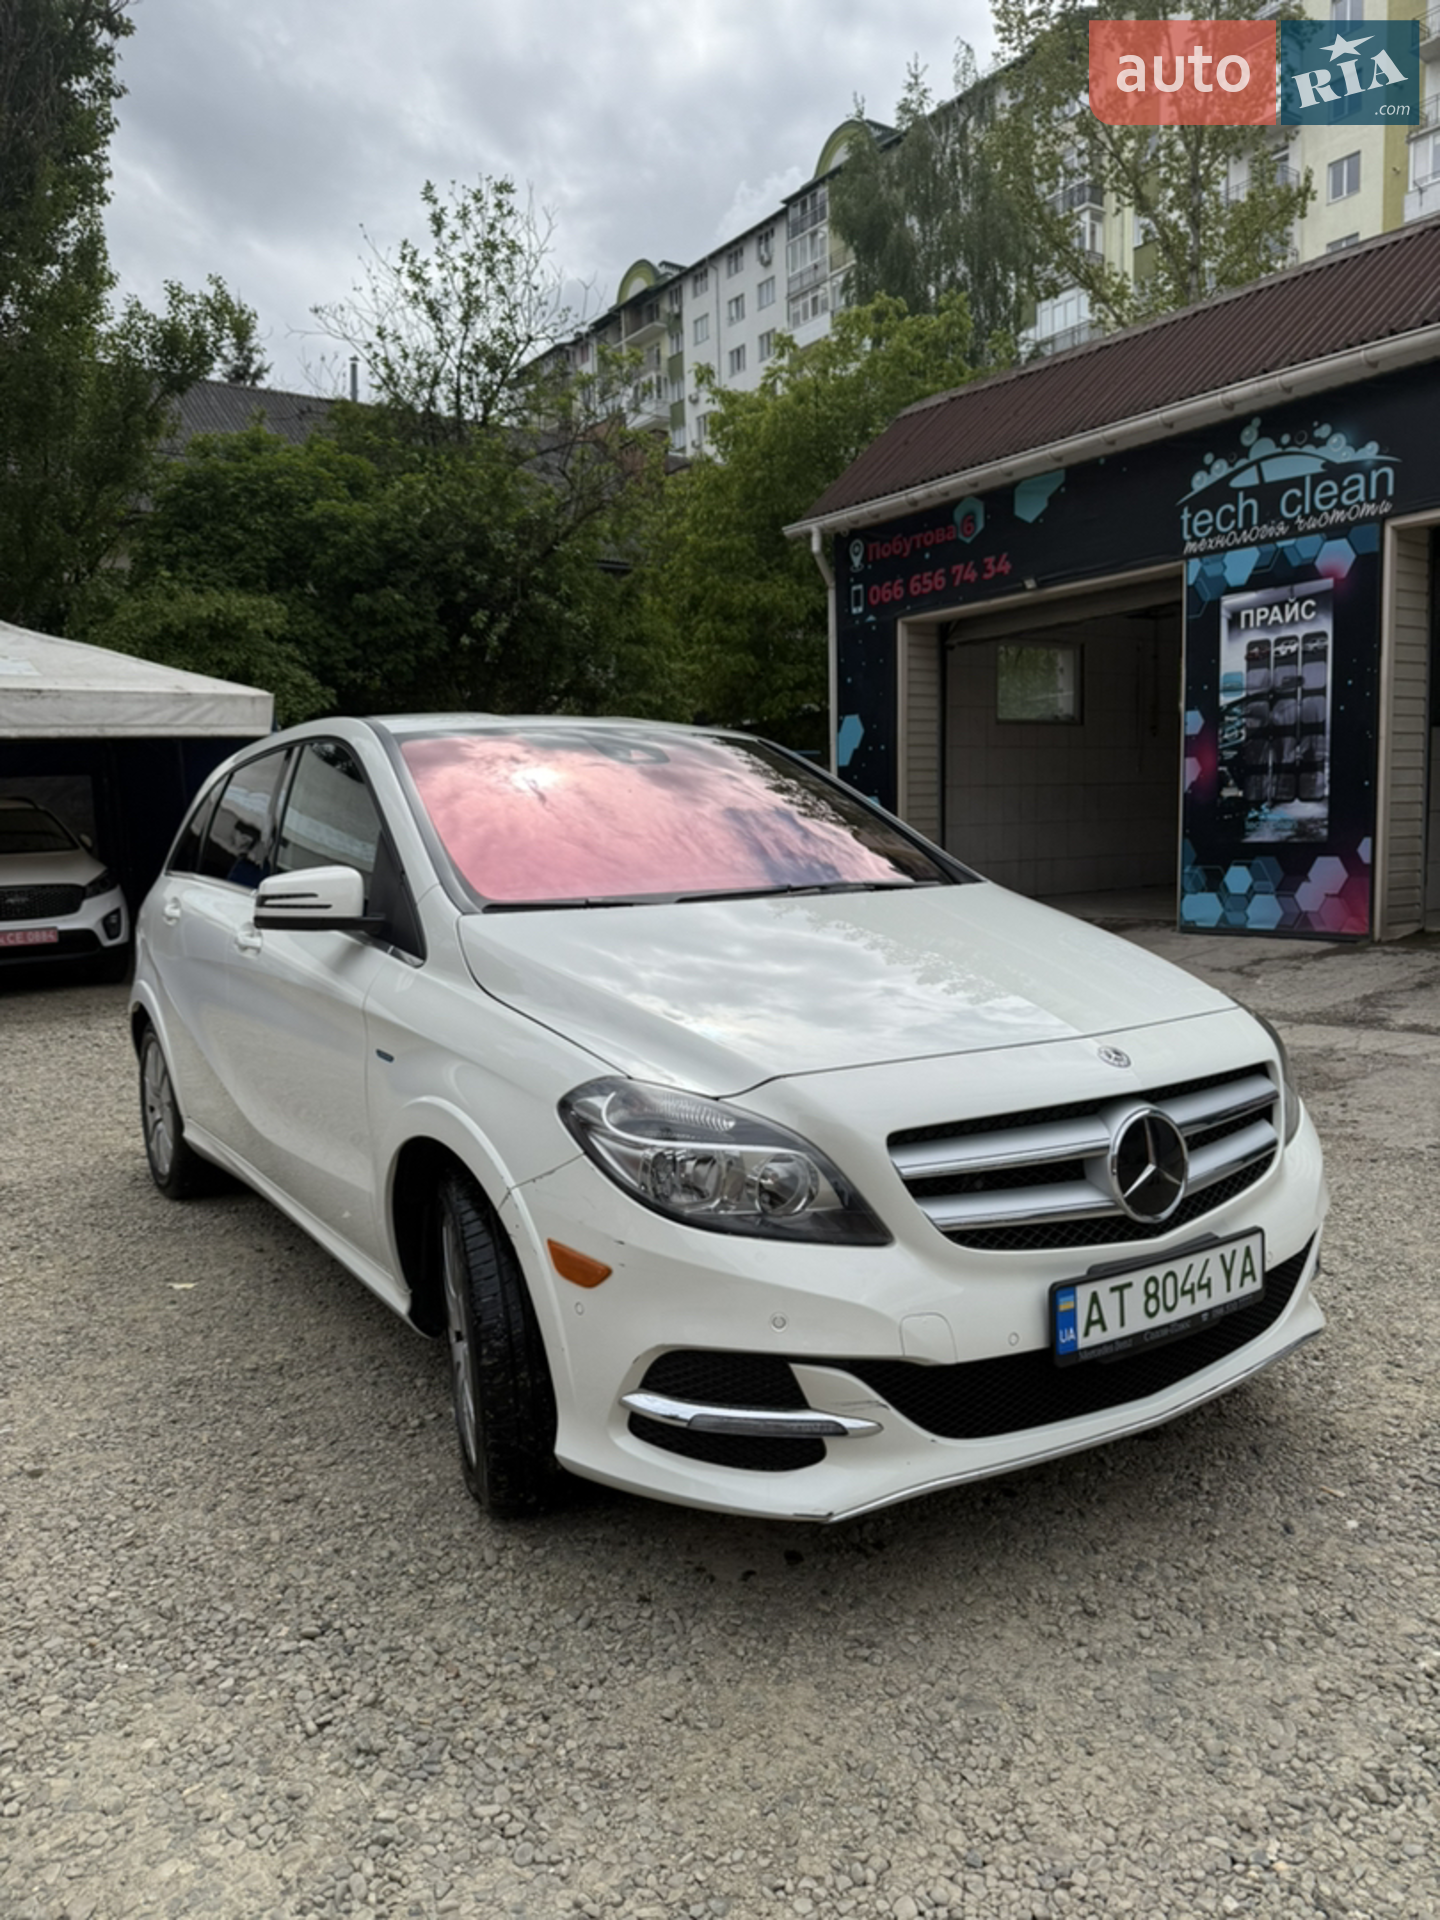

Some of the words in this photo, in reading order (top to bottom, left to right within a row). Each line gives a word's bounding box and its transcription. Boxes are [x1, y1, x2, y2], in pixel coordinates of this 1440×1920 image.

[1180, 491, 1258, 540] tech
[1280, 466, 1394, 518] clean
[867, 524, 957, 562] Побутова
[960, 515, 975, 538] 6
[868, 579, 904, 606] 066
[909, 568, 946, 597] 656
[951, 561, 978, 587] 74
[982, 553, 1012, 580] 34
[1240, 597, 1317, 630] ПРАЙС
[1083, 1281, 1134, 1338] AT
[1143, 1257, 1212, 1319] 8044
[1219, 1245, 1257, 1294] YA
[1059, 1328, 1076, 1343] UA
